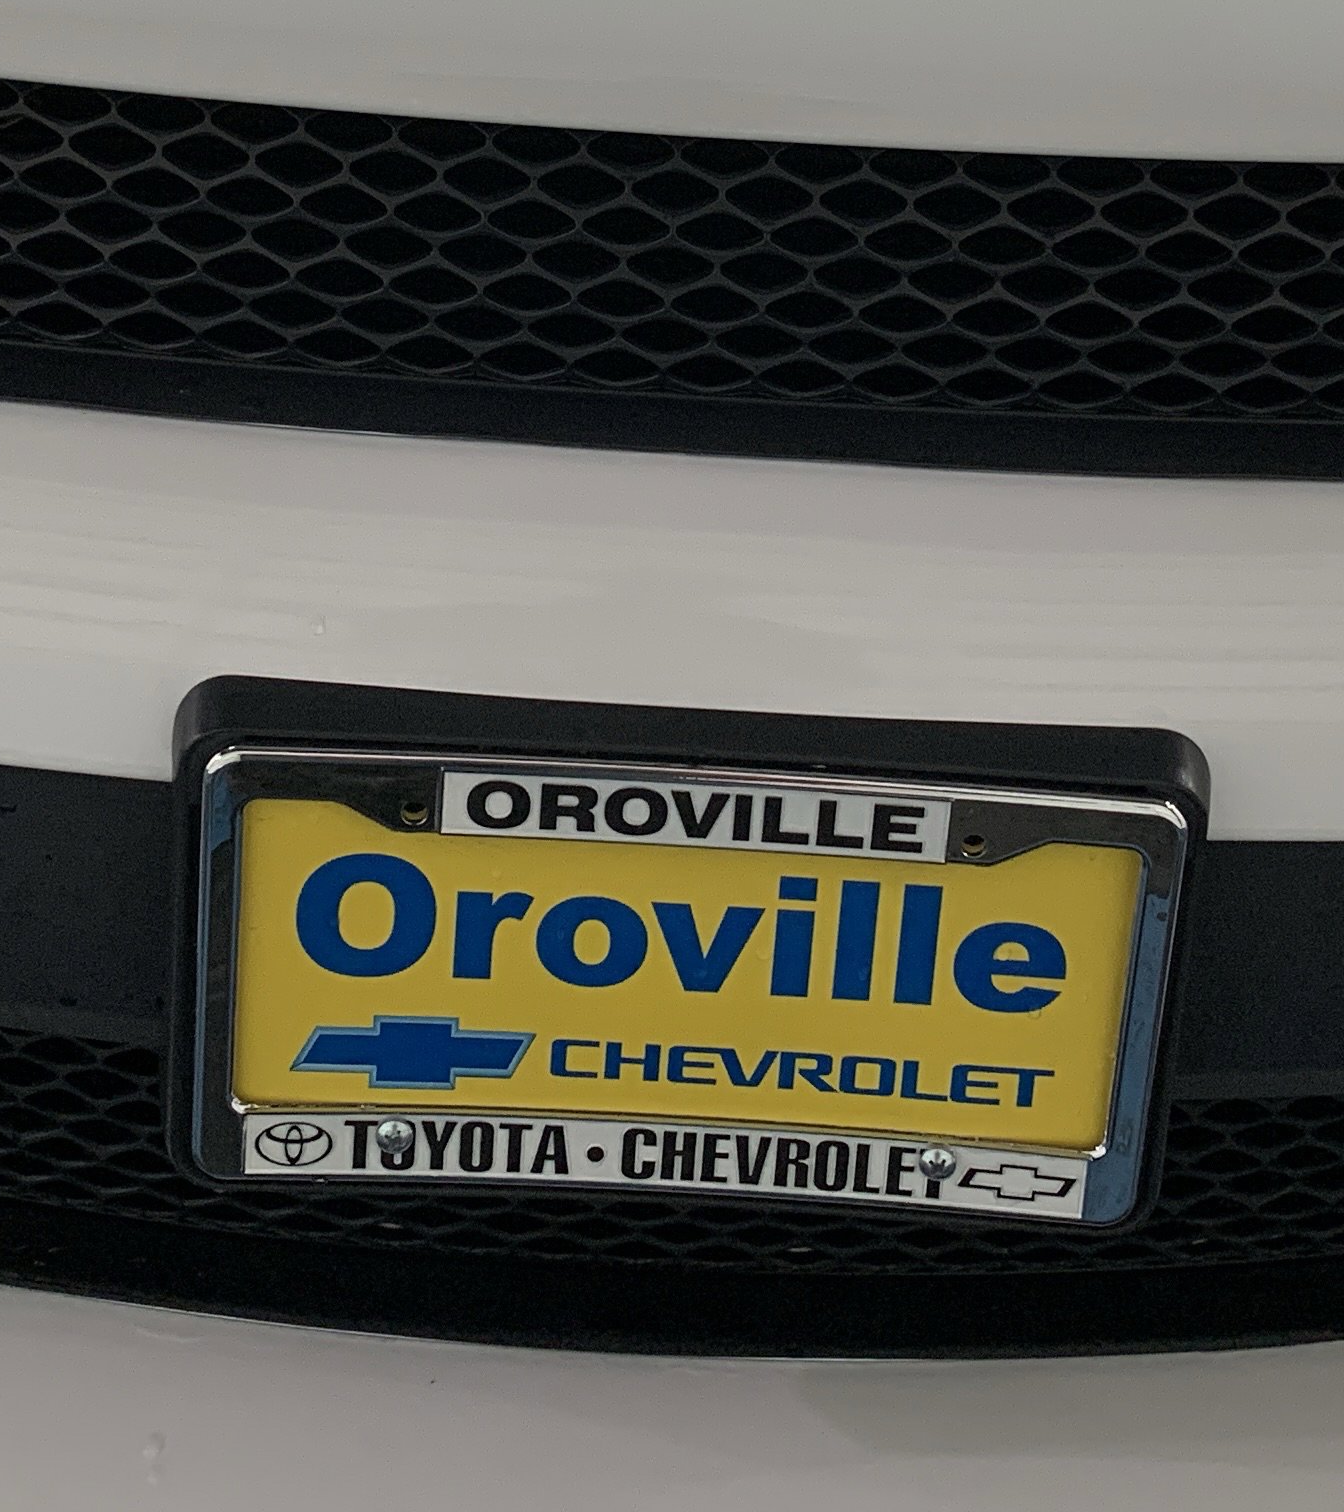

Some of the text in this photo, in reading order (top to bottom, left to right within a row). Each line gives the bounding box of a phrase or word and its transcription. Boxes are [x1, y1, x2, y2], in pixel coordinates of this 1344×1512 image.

[465, 780, 926, 854] OROVILLE
[295, 853, 1068, 1013] Oroville
[549, 1038, 1056, 1107] CHEVROLET
